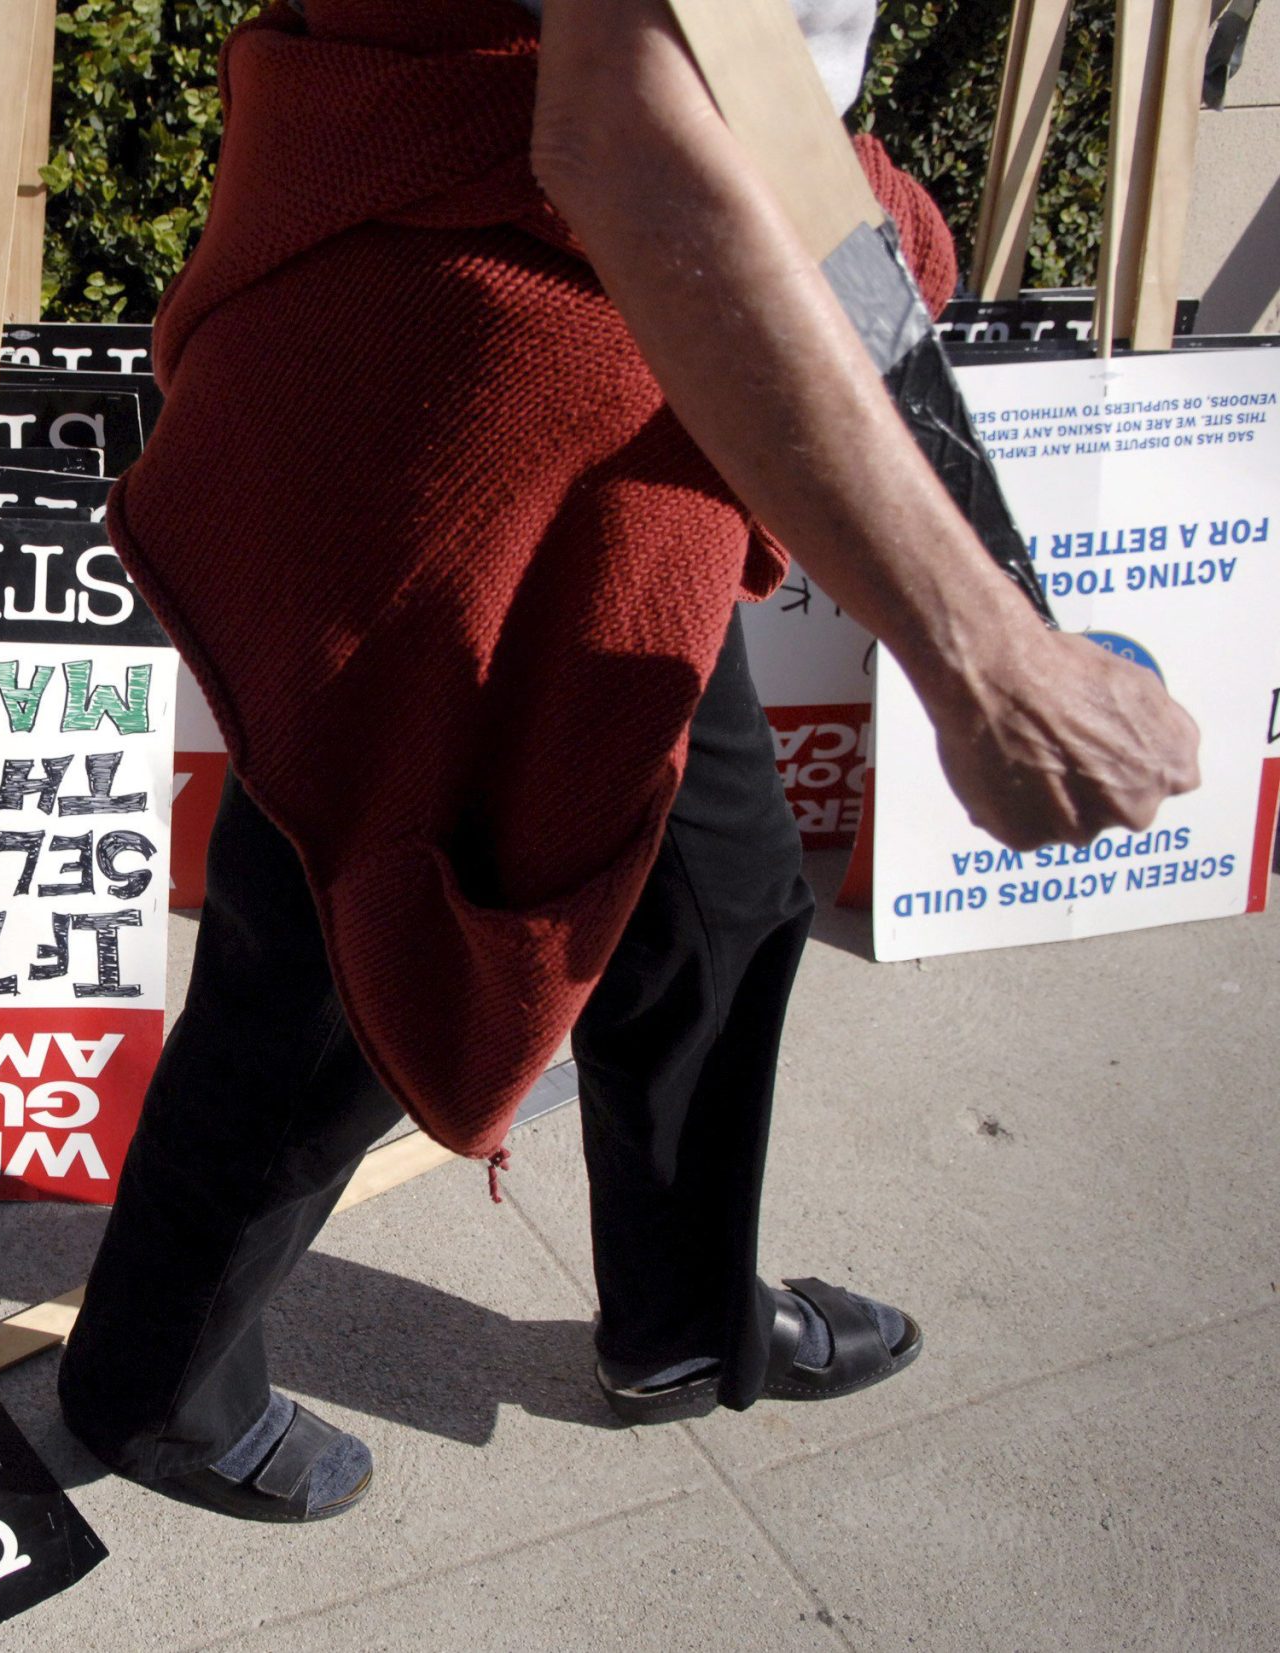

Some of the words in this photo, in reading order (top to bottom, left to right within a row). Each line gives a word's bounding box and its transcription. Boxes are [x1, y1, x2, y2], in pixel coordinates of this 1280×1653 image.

[1104, 399, 1179, 414] SUPPLIERS
[1183, 397, 1202, 410] OR
[1207, 393, 1278, 409] VENDORS,
[1001, 406, 1077, 422] WITHHOLD
[1082, 405, 1100, 417] TO
[1237, 411, 1267, 424] THIS
[1116, 420, 1142, 433] NOT
[1145, 418, 1172, 431] ARE
[1176, 417, 1197, 428] WE
[1201, 413, 1233, 427] SITE.
[979, 429, 1019, 442] EMPL
[1023, 426, 1052, 439] ANY
[1057, 423, 1112, 437] ASKING
[1227, 430, 1255, 443] SAG
[1115, 435, 1169, 451] DISPUTE
[1174, 435, 1193, 446] NO
[1196, 433, 1223, 445] HAS
[987, 445, 1036, 460] EMPLO
[1041, 443, 1071, 456] ANY
[1075, 440, 1111, 453] WITH
[1180, 523, 1198, 549] A
[1208, 517, 1269, 547] FOR
[1050, 526, 1168, 559] BETTER
[1126, 557, 1238, 591] ACTING
[1035, 826, 1191, 868] SUPPORTS
[952, 848, 1023, 876] WGA
[1125, 854, 1236, 891] SCREEN
[999, 871, 1118, 906] ACTORS
[893, 886, 988, 918] GUILD
[28, 909, 144, 999] IF
